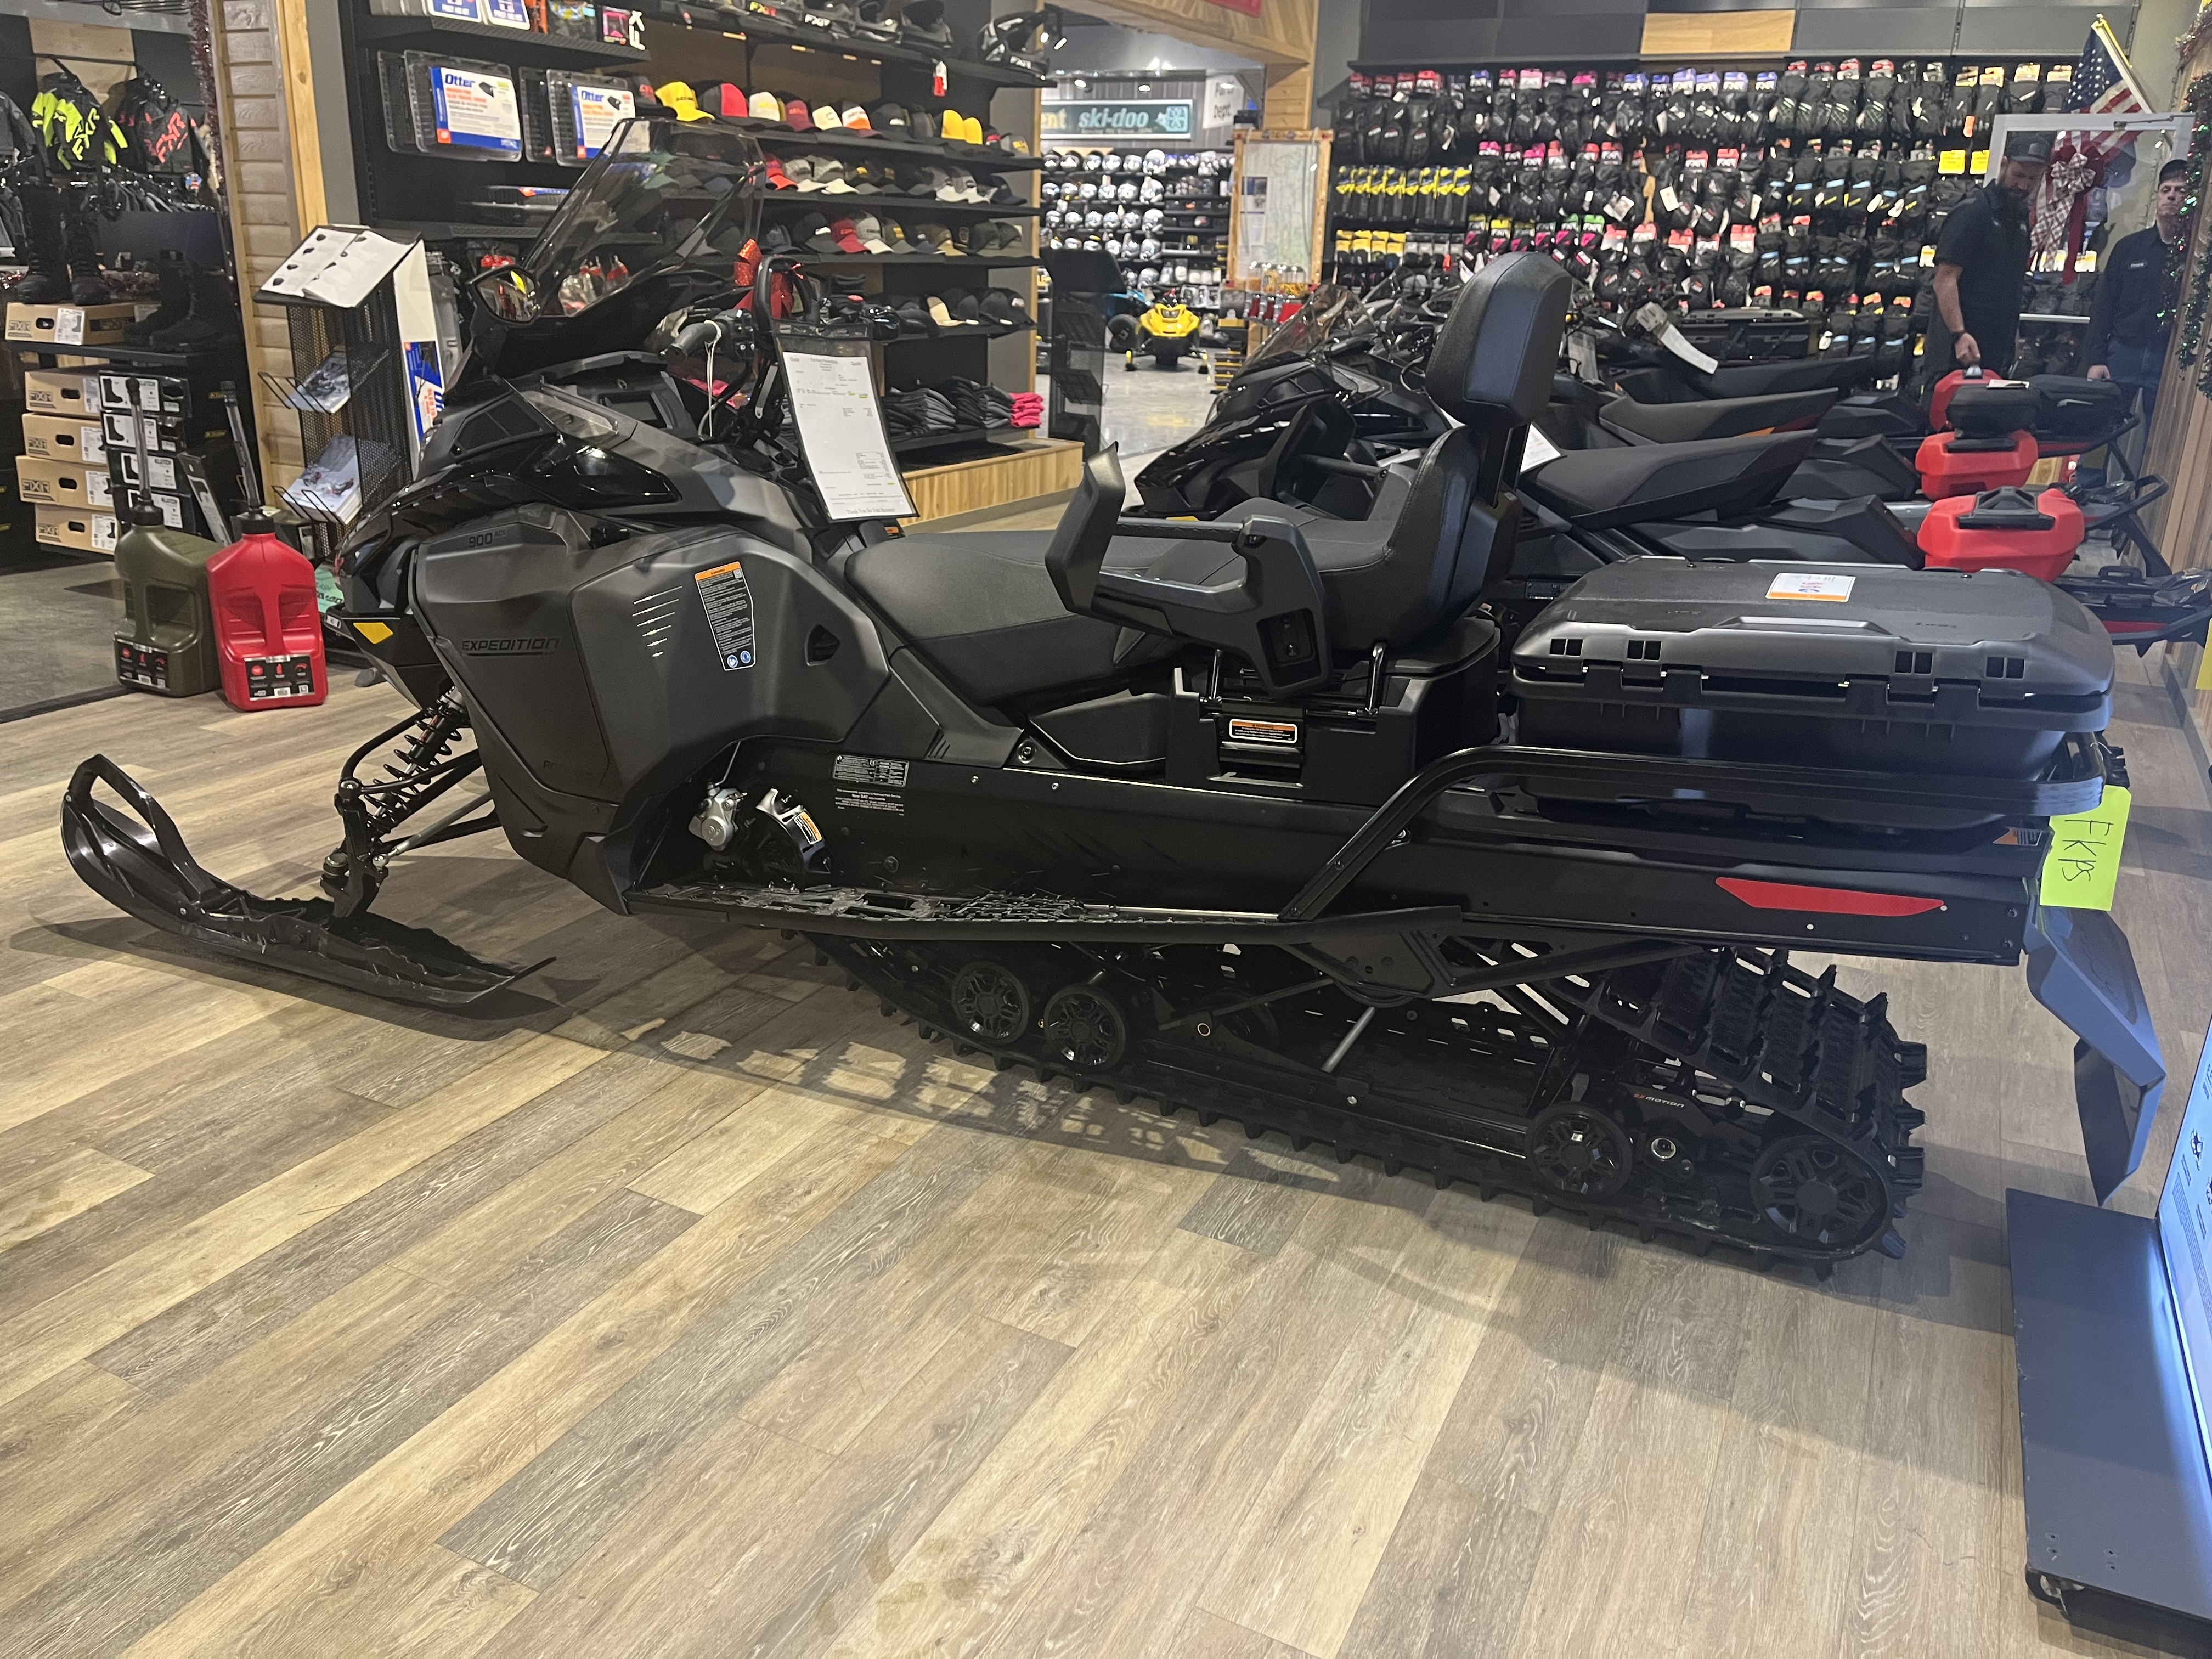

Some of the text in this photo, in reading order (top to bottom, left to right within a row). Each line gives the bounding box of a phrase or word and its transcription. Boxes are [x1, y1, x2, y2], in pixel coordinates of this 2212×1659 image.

[445, 74, 476, 88] Otter
[1078, 107, 1149, 128] ski-doo
[469, 533, 493, 548] 900
[462, 638, 561, 651] EXPEDITION
